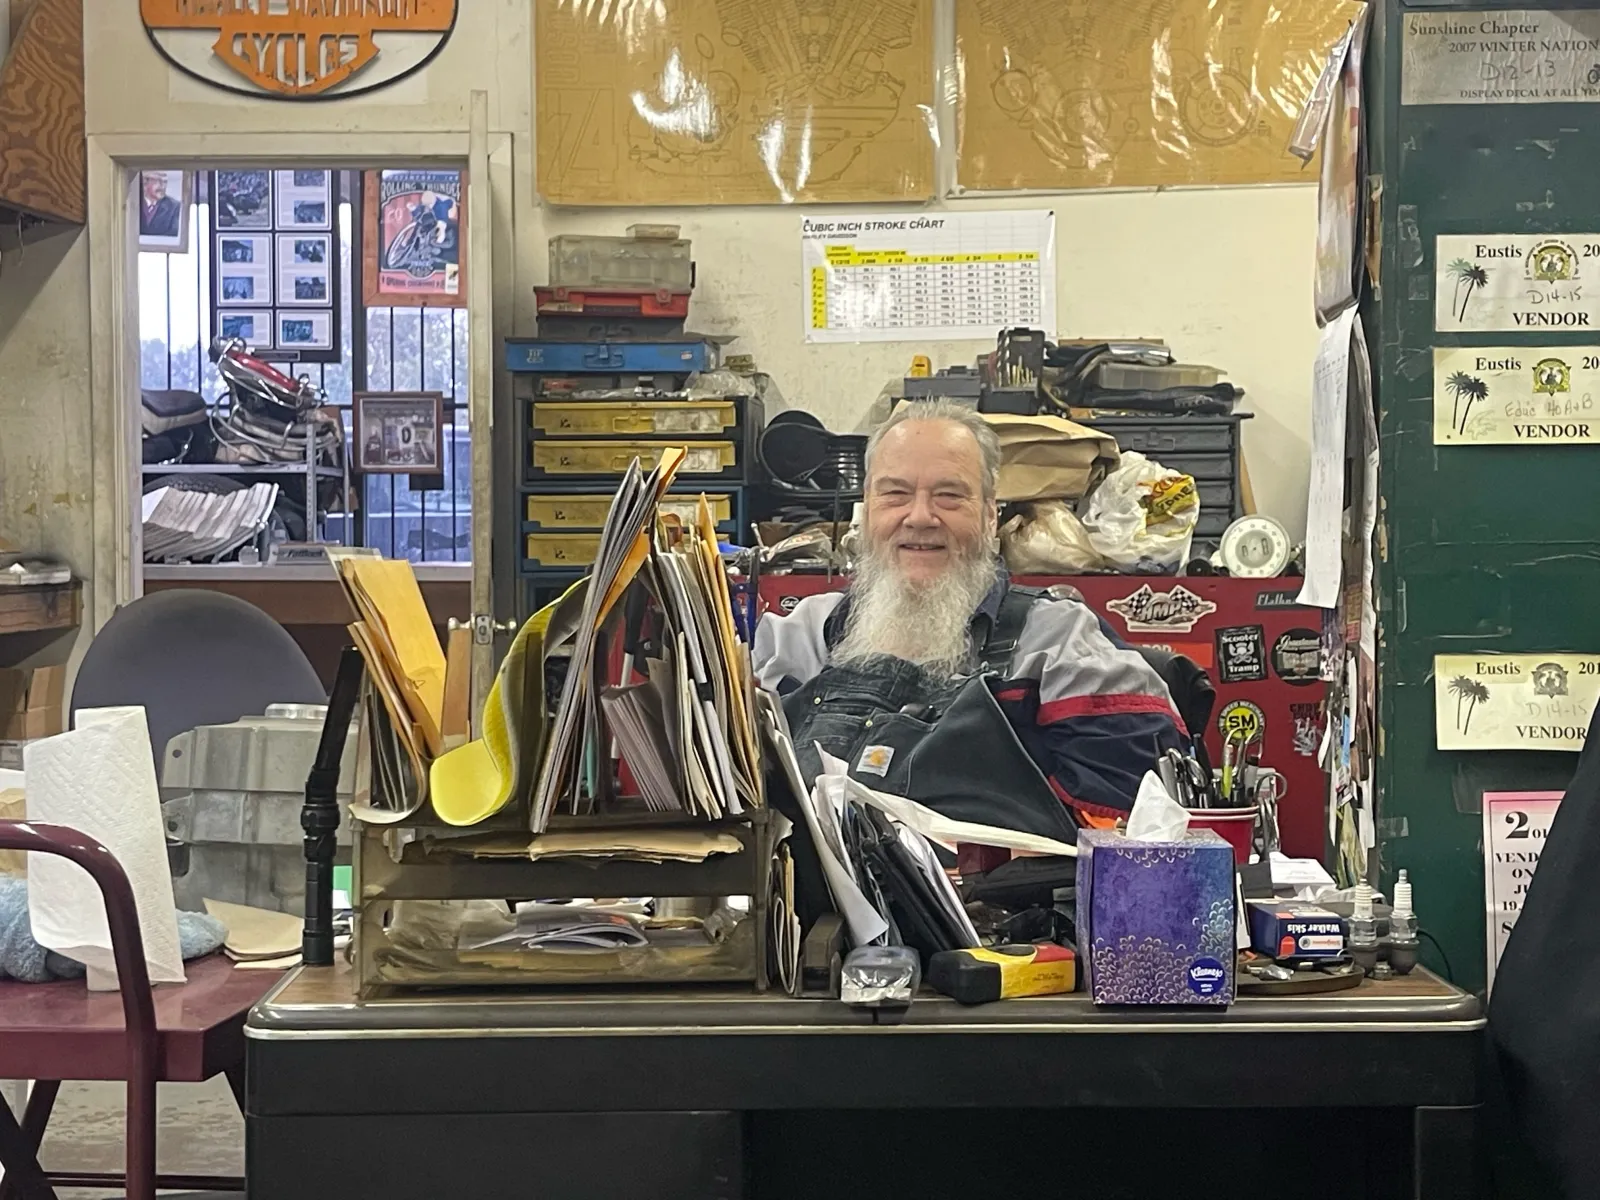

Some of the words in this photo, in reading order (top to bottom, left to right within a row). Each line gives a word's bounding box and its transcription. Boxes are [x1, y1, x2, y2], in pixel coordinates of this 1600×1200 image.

[1409, 21, 1476, 35] Sunshine
[1480, 21, 1539, 37] Chapter
[1449, 43, 1476, 53] 2007
[1480, 41, 1536, 52] WINTER
[233, 32, 360, 88] CYCLES
[1460, 89, 1503, 98] DISPLAY
[1506, 89, 1540, 97] DECAL
[1543, 88, 1559, 97] AT
[1560, 88, 1579, 97] ALL
[803, 223, 834, 232] CUBIC
[837, 222, 861, 231] INCH
[864, 220, 906, 230] STROKE
[909, 219, 944, 229] CHART
[1475, 244, 1522, 258] Eustis
[1513, 312, 1589, 325] VENDOR
[1475, 357, 1522, 370] Eustis
[1513, 424, 1590, 438] VENDOR
[1221, 633, 1259, 643] Scooter
[1228, 664, 1259, 673] Tramp
[1475, 661, 1521, 675] Eustis
[1516, 726, 1586, 739] VENDOR
[1505, 811, 1548, 839] 201
[1496, 852, 1539, 863] VEND
[1287, 924, 1306, 933] Skis
[1308, 924, 1340, 933] Walker
